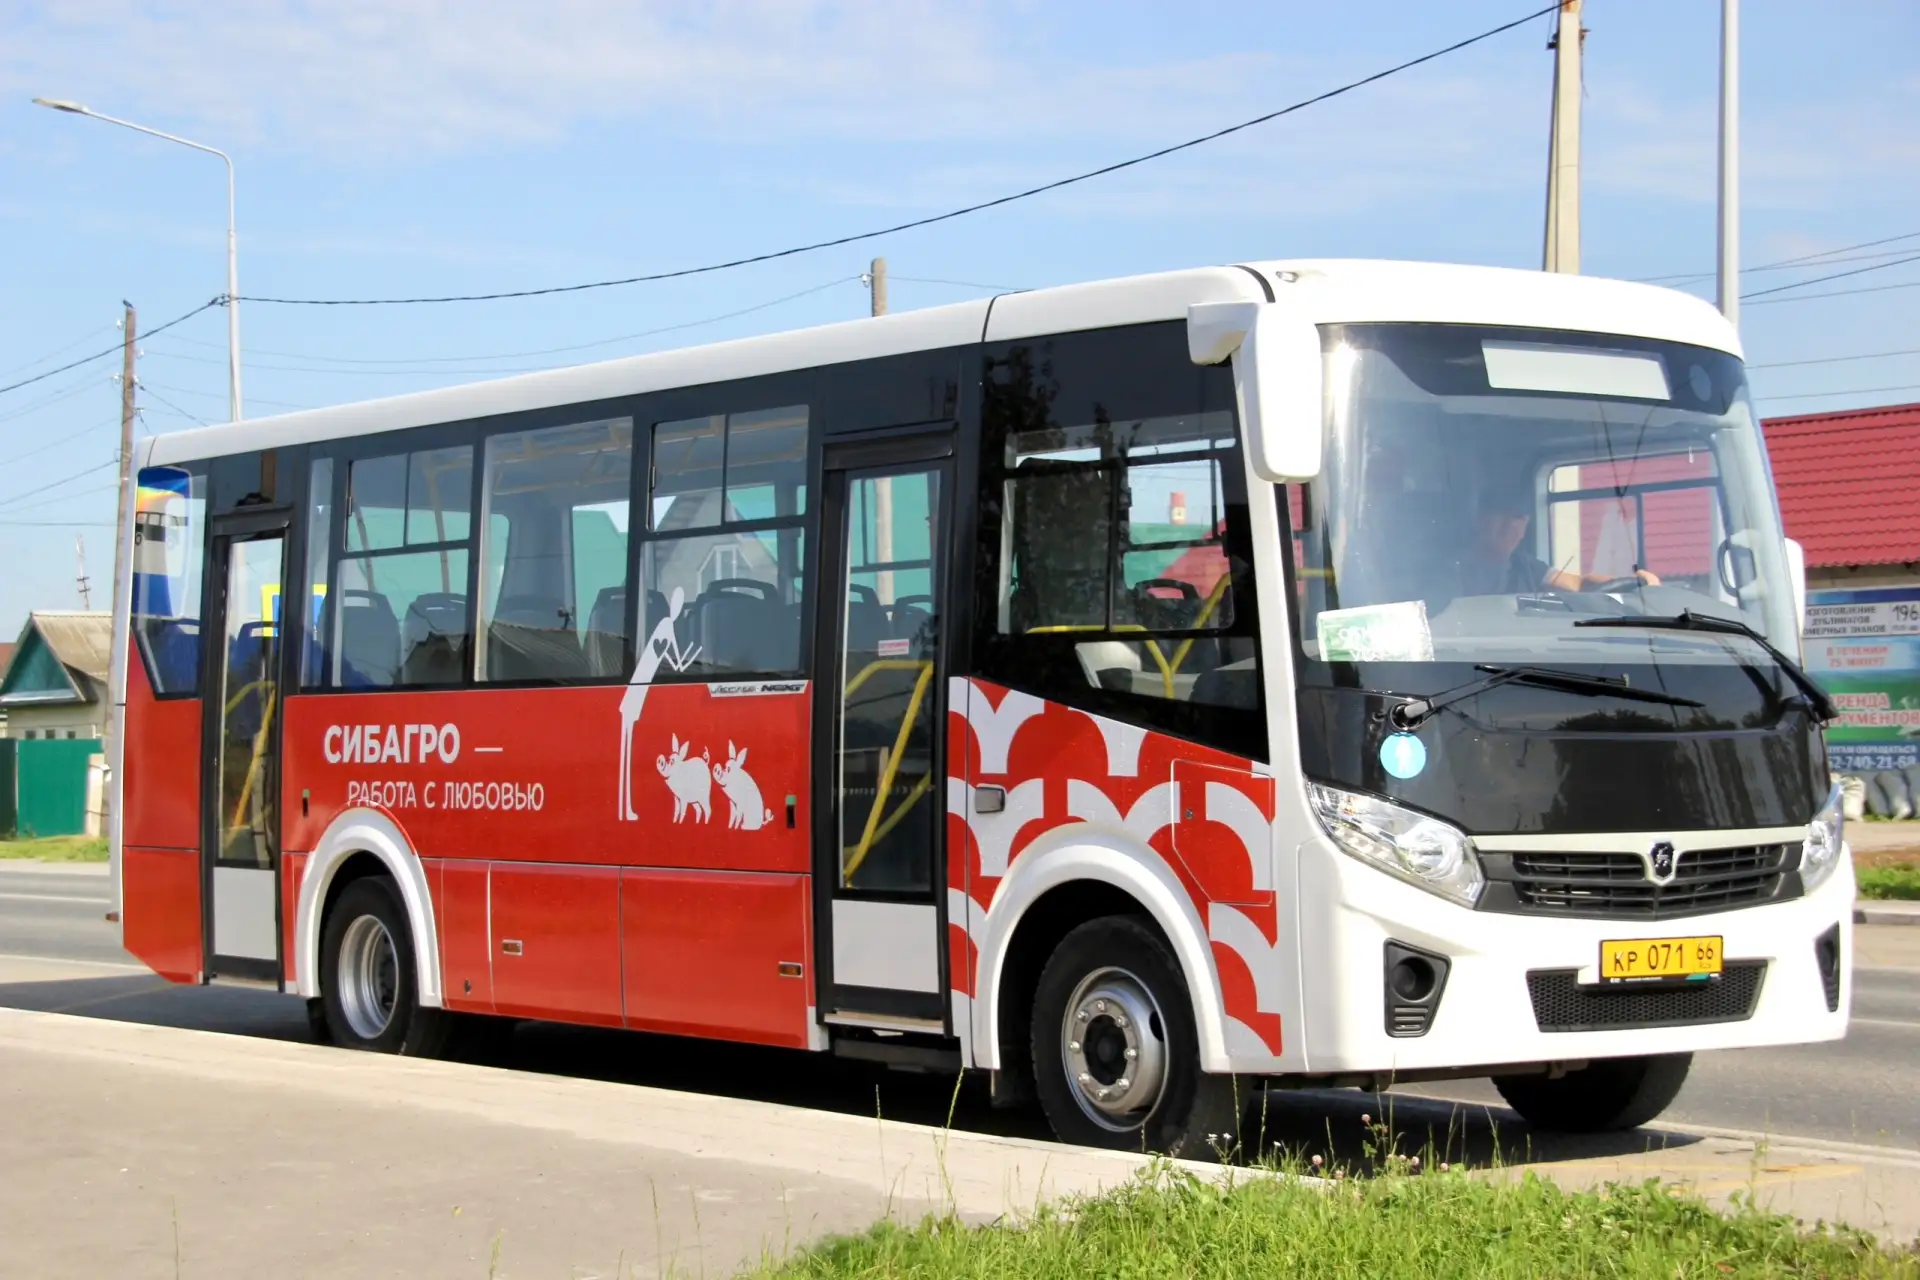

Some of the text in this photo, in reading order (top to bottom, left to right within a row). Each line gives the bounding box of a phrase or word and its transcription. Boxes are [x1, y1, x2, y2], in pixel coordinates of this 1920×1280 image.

[1892, 604, 1919, 621] 196
[1804, 627, 1847, 636] ОМЕРНЫХ
[1851, 624, 1886, 634] ЗНАКОВ
[323, 723, 460, 764] СИБАГРО
[347, 780, 544, 811] РАБОТА С ЛЮБОВЬЮ
[1647, 944, 1684, 970] 071
[1696, 940, 1714, 960] 66
